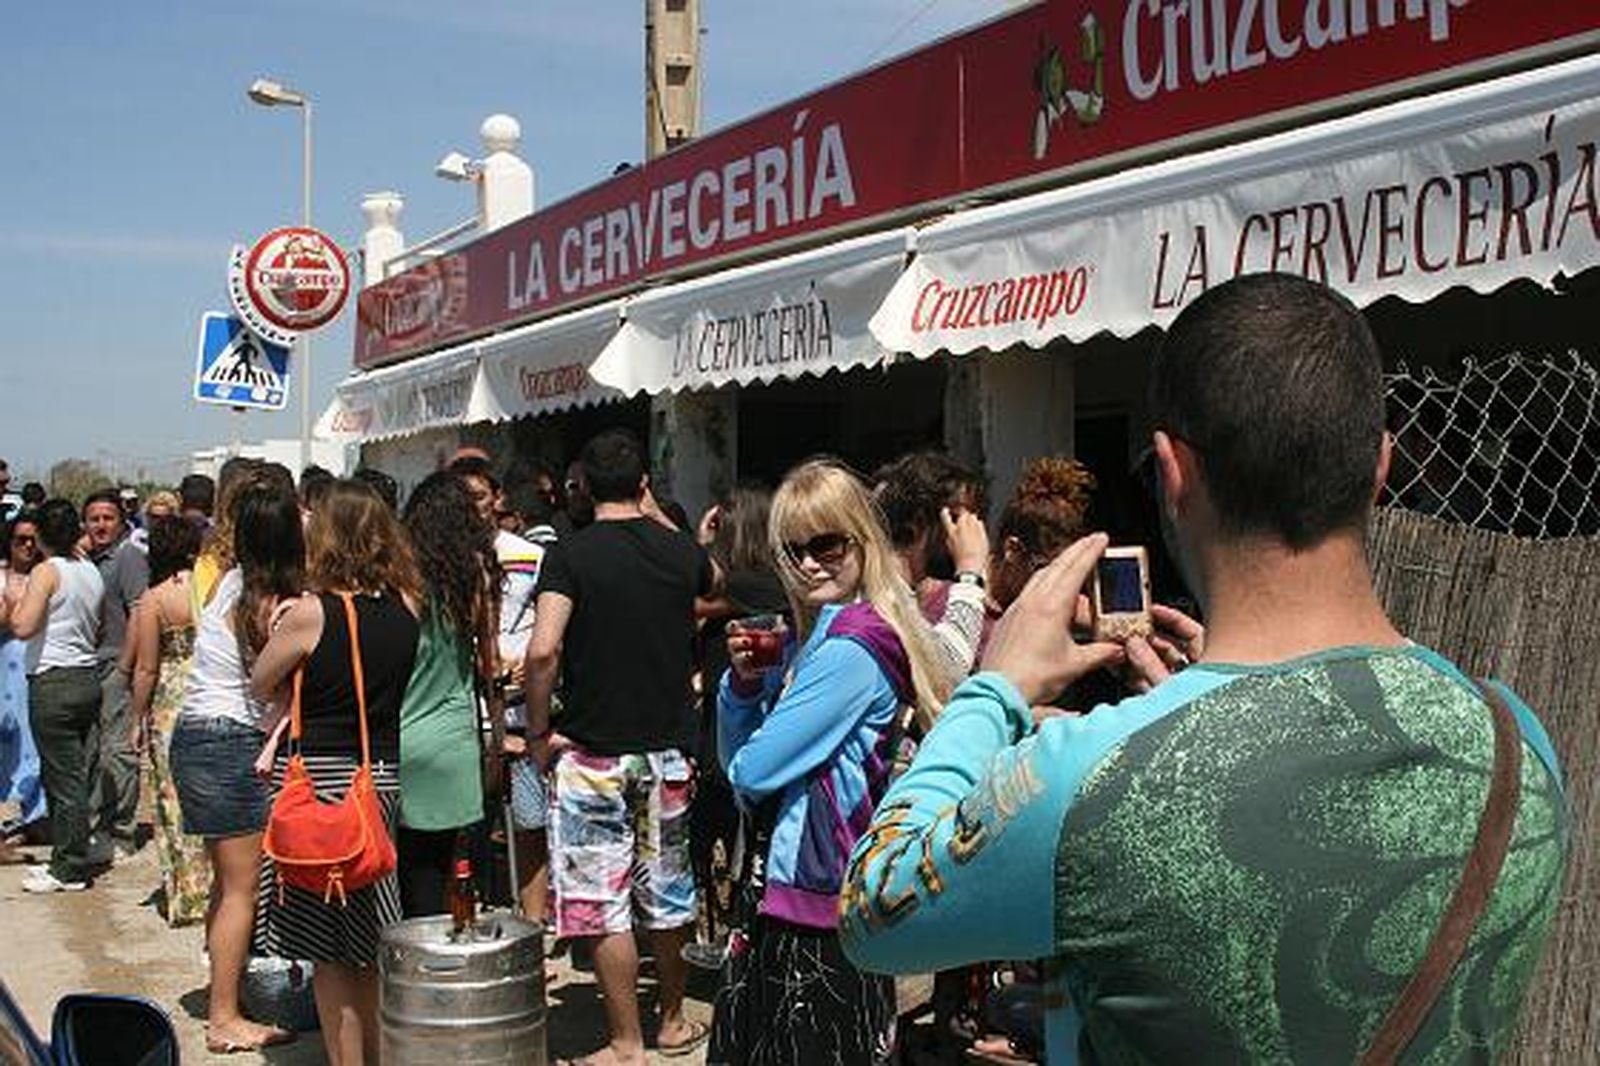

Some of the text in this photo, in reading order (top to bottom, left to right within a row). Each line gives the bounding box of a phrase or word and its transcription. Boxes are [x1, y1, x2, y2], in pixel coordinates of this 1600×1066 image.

[508, 240, 548, 310] LA
[558, 109, 855, 293] CERVECERÍA
[911, 265, 1083, 333] Cruzcampo
[1153, 224, 1209, 309] LA
[696, 279, 833, 373] CERVECERÍA
